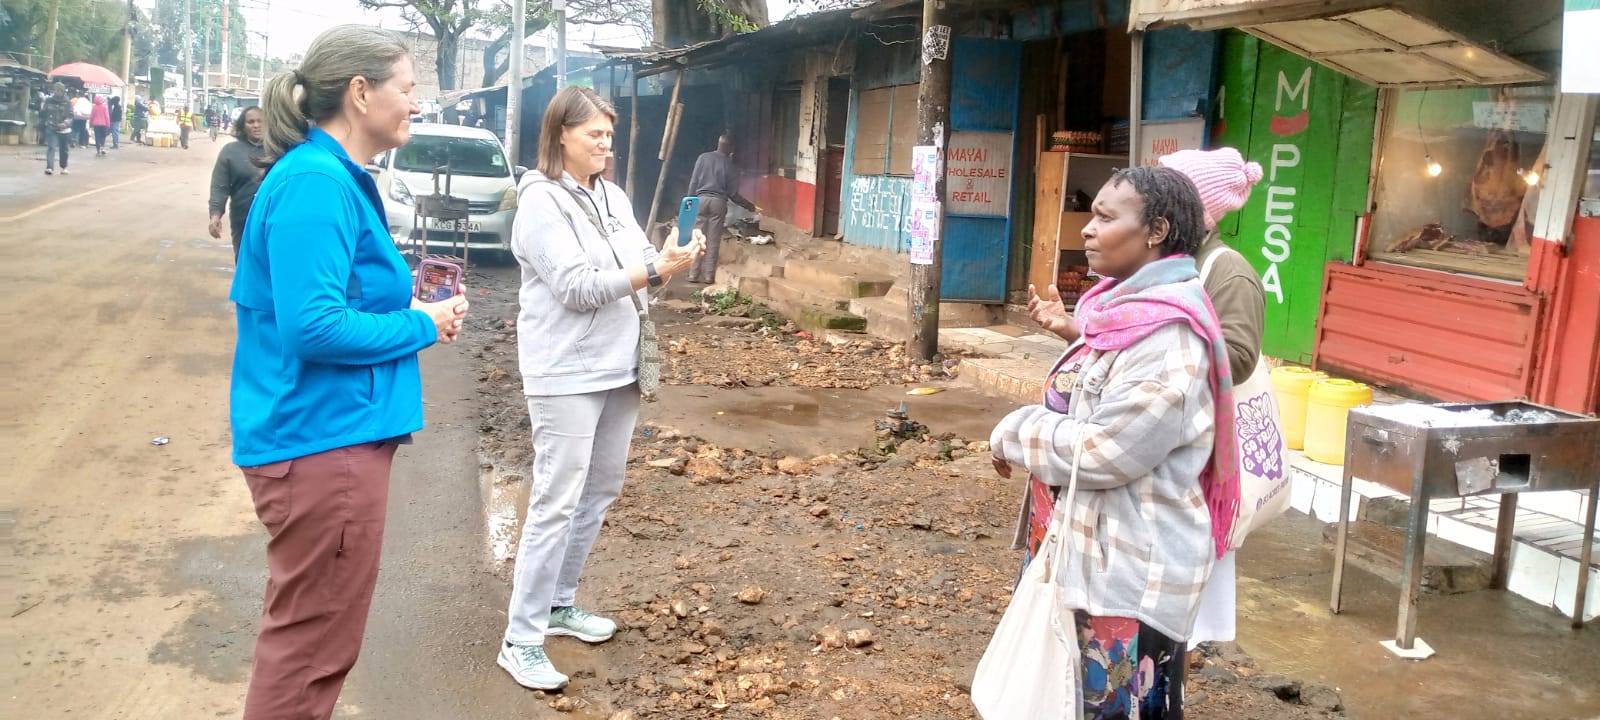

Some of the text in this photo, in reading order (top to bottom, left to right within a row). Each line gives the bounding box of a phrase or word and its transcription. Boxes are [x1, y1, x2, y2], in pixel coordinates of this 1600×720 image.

[1152, 138, 1178, 154] MAYAI
[948, 148, 987, 162] MAYAI
[947, 167, 1005, 178] HOLESALE
[953, 191, 992, 203] RETAIL
[434, 219, 452, 230] KCG
[1261, 144, 1300, 304] PESA
